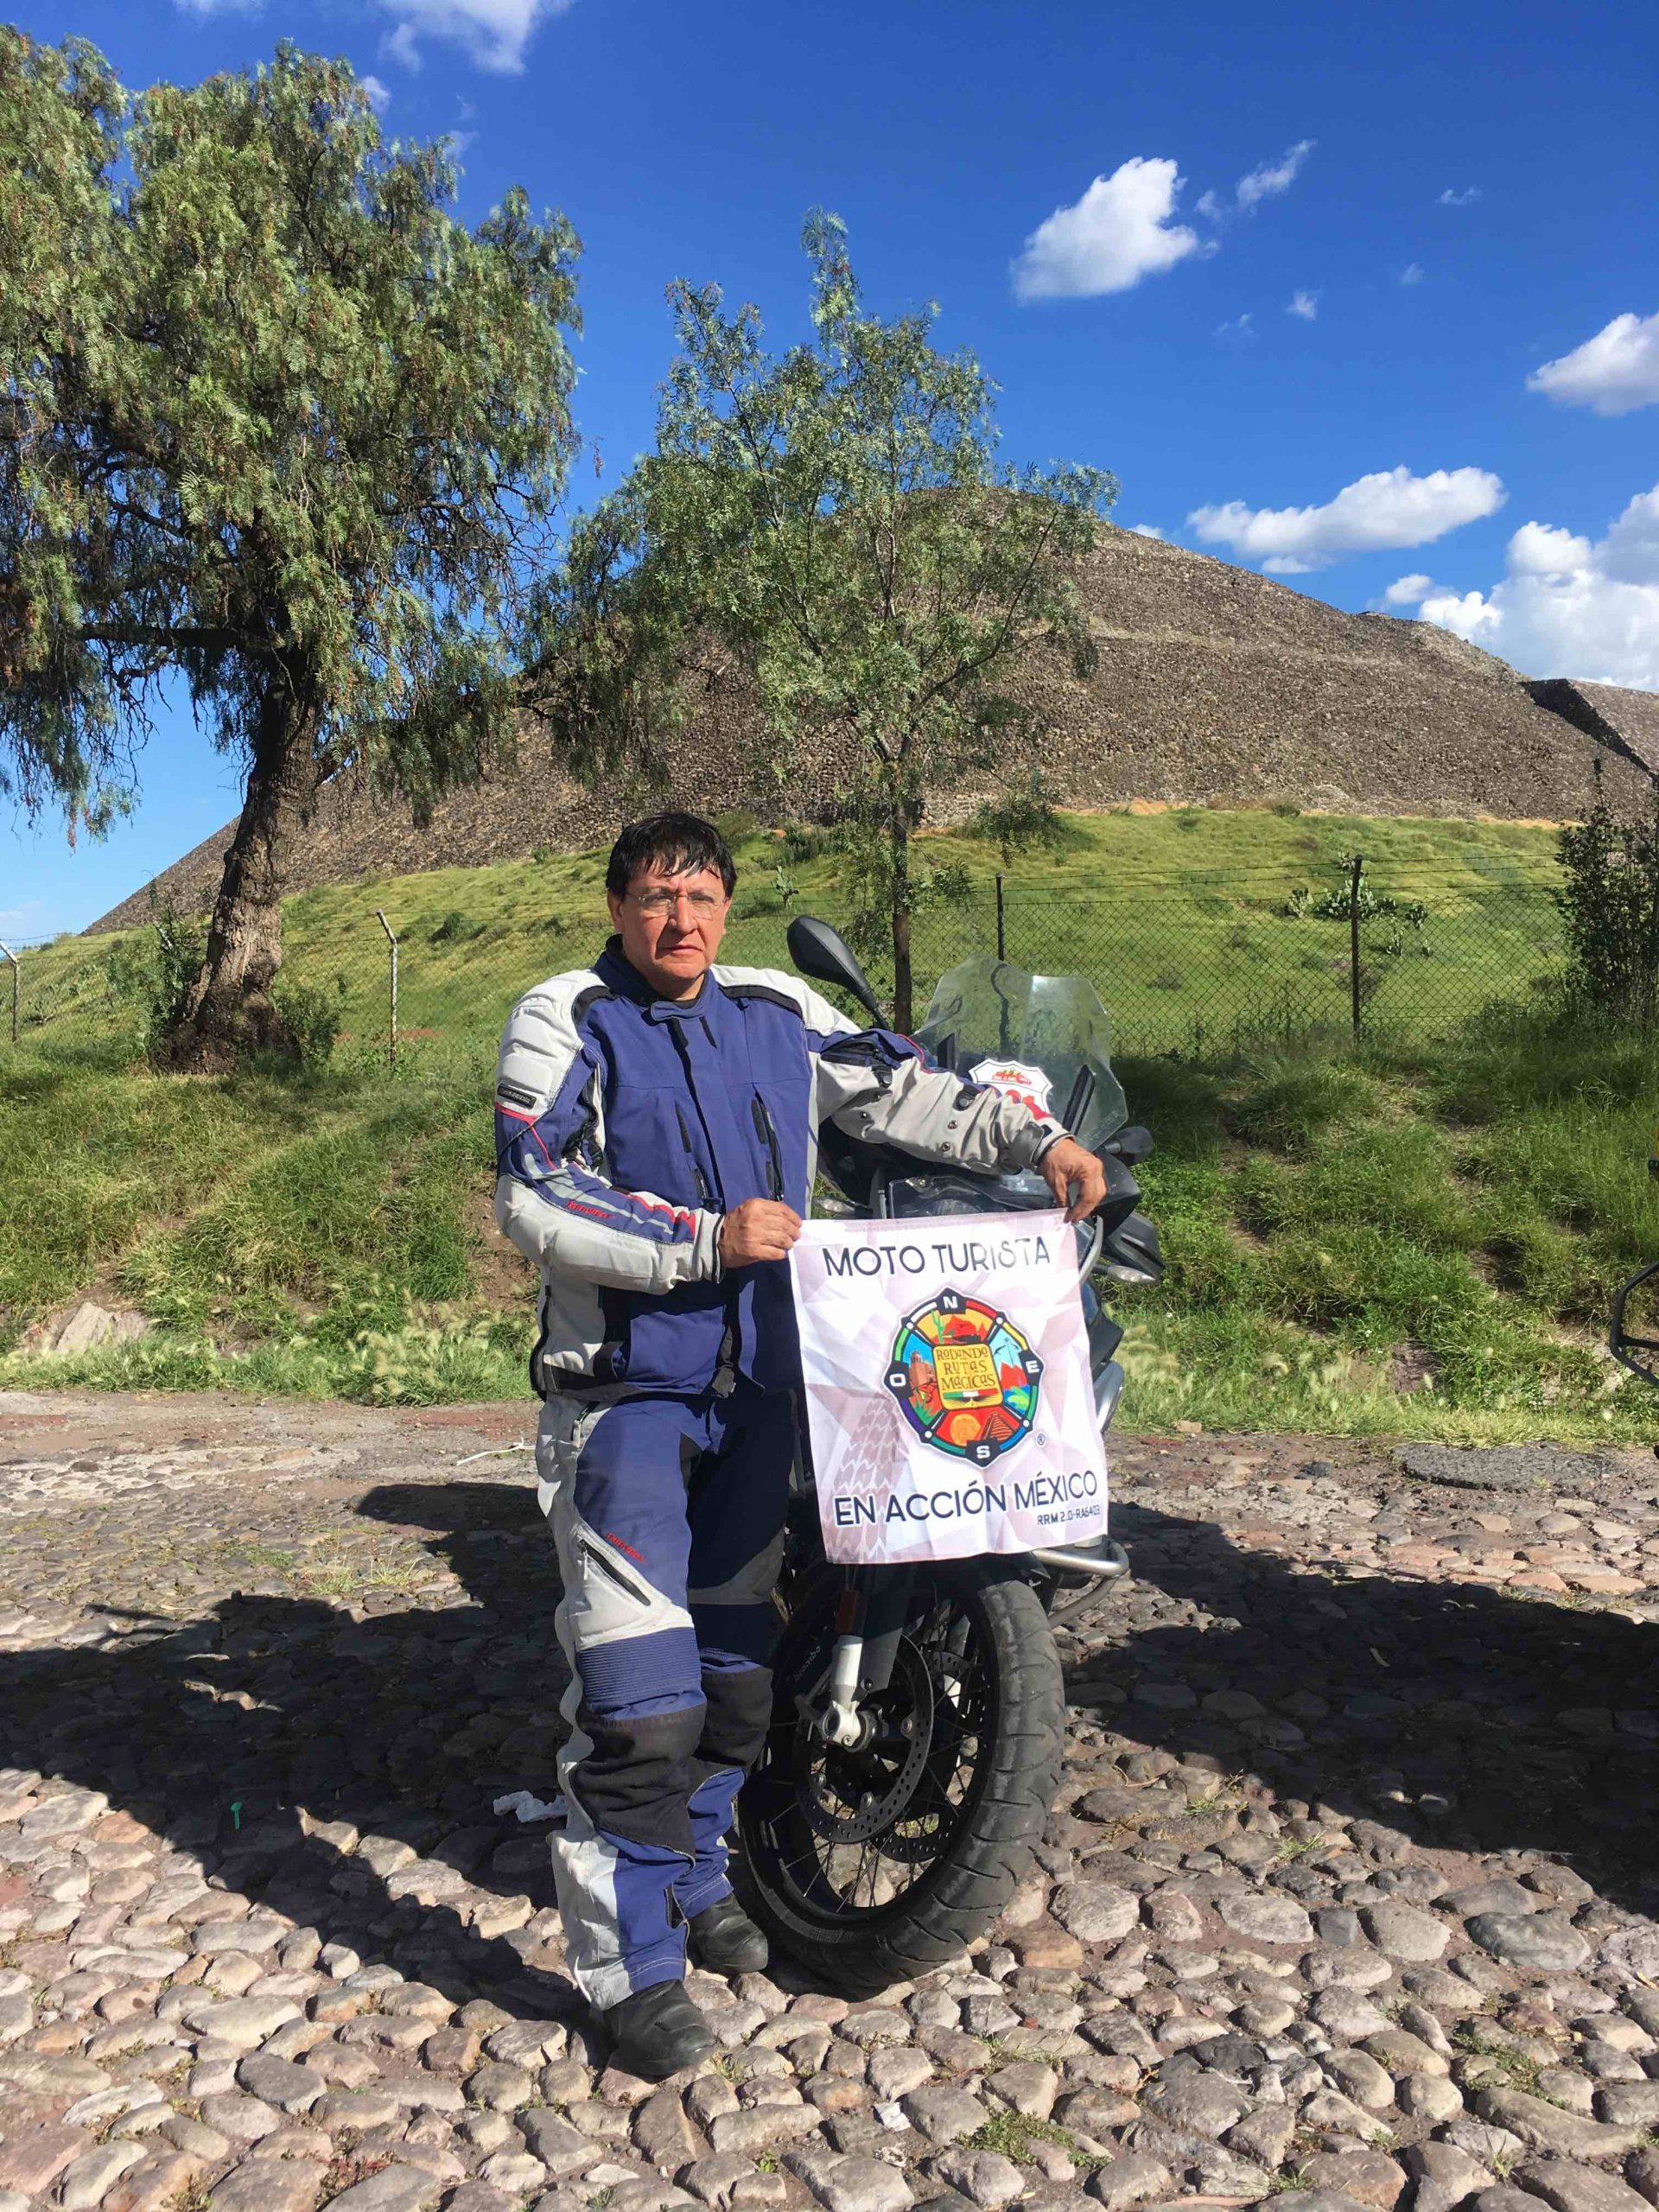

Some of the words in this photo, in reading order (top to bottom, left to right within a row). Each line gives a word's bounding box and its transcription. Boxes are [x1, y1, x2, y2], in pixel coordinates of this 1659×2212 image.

[822, 1245, 925, 1276] MOTO
[931, 1236, 1051, 1274] TURISTA
[943, 1296, 958, 1309] N
[1026, 1360, 1039, 1374] E
[889, 1373, 906, 1387] O
[976, 1445, 991, 1459] S
[834, 1495, 876, 1526] EN
[885, 1480, 1007, 1522] ACCIÓN
[1014, 1470, 1098, 1510] MÉXICO
[1037, 1513, 1058, 1526] RRM
